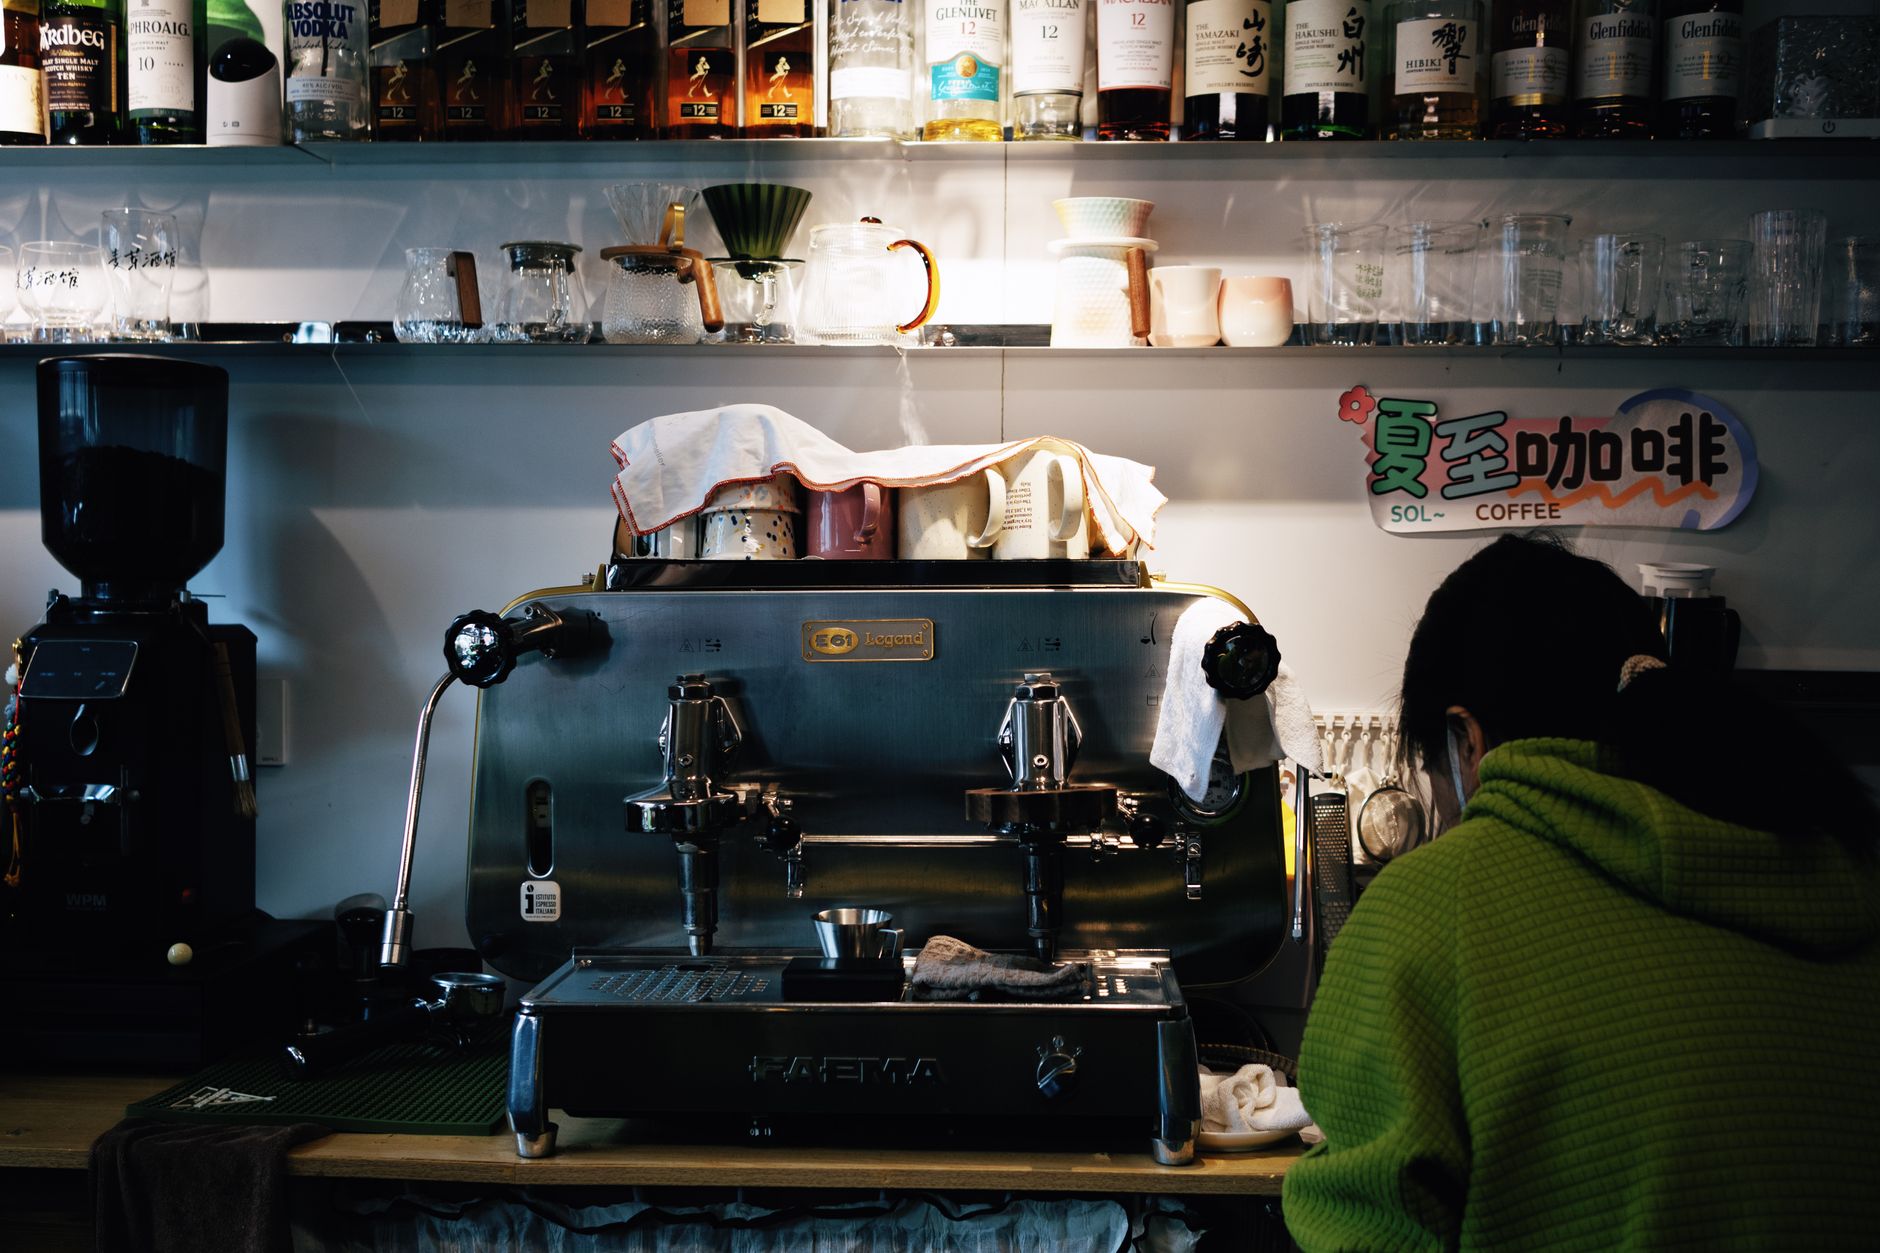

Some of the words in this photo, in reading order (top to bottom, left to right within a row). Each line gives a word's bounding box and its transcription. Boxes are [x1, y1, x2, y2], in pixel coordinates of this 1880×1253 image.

[287, 1, 356, 23] ABSOLUT
[935, 7, 998, 22] GLENLIVET
[1131, 13, 1146, 25] 12
[291, 20, 349, 40] VODKA
[961, 21, 977, 35] 12
[1042, 25, 1058, 39] 12
[1196, 23, 1209, 31] THE
[1296, 22, 1309, 30] THE
[1195, 30, 1240, 40] YAMAZAKI
[1295, 29, 1340, 40] HAKUSHU
[1337, 7, 1366, 82] 白州
[80, 58, 99, 66] MALT
[139, 56, 155, 71] 10
[1405, 58, 1442, 69] HIBIKI
[57, 72, 76, 80] TEN
[537, 107, 550, 118] 12
[609, 106, 623, 117] 12
[692, 105, 706, 116] 12
[772, 105, 786, 116] 12
[1371, 397, 1729, 501] 夏至咖啡
[1475, 502, 1562, 521] COFFEE
[815, 634, 853, 648] E61
[864, 631, 925, 648] Legend
[65, 894, 107, 906] WPM
[746, 1055, 945, 1085] FAEMA
